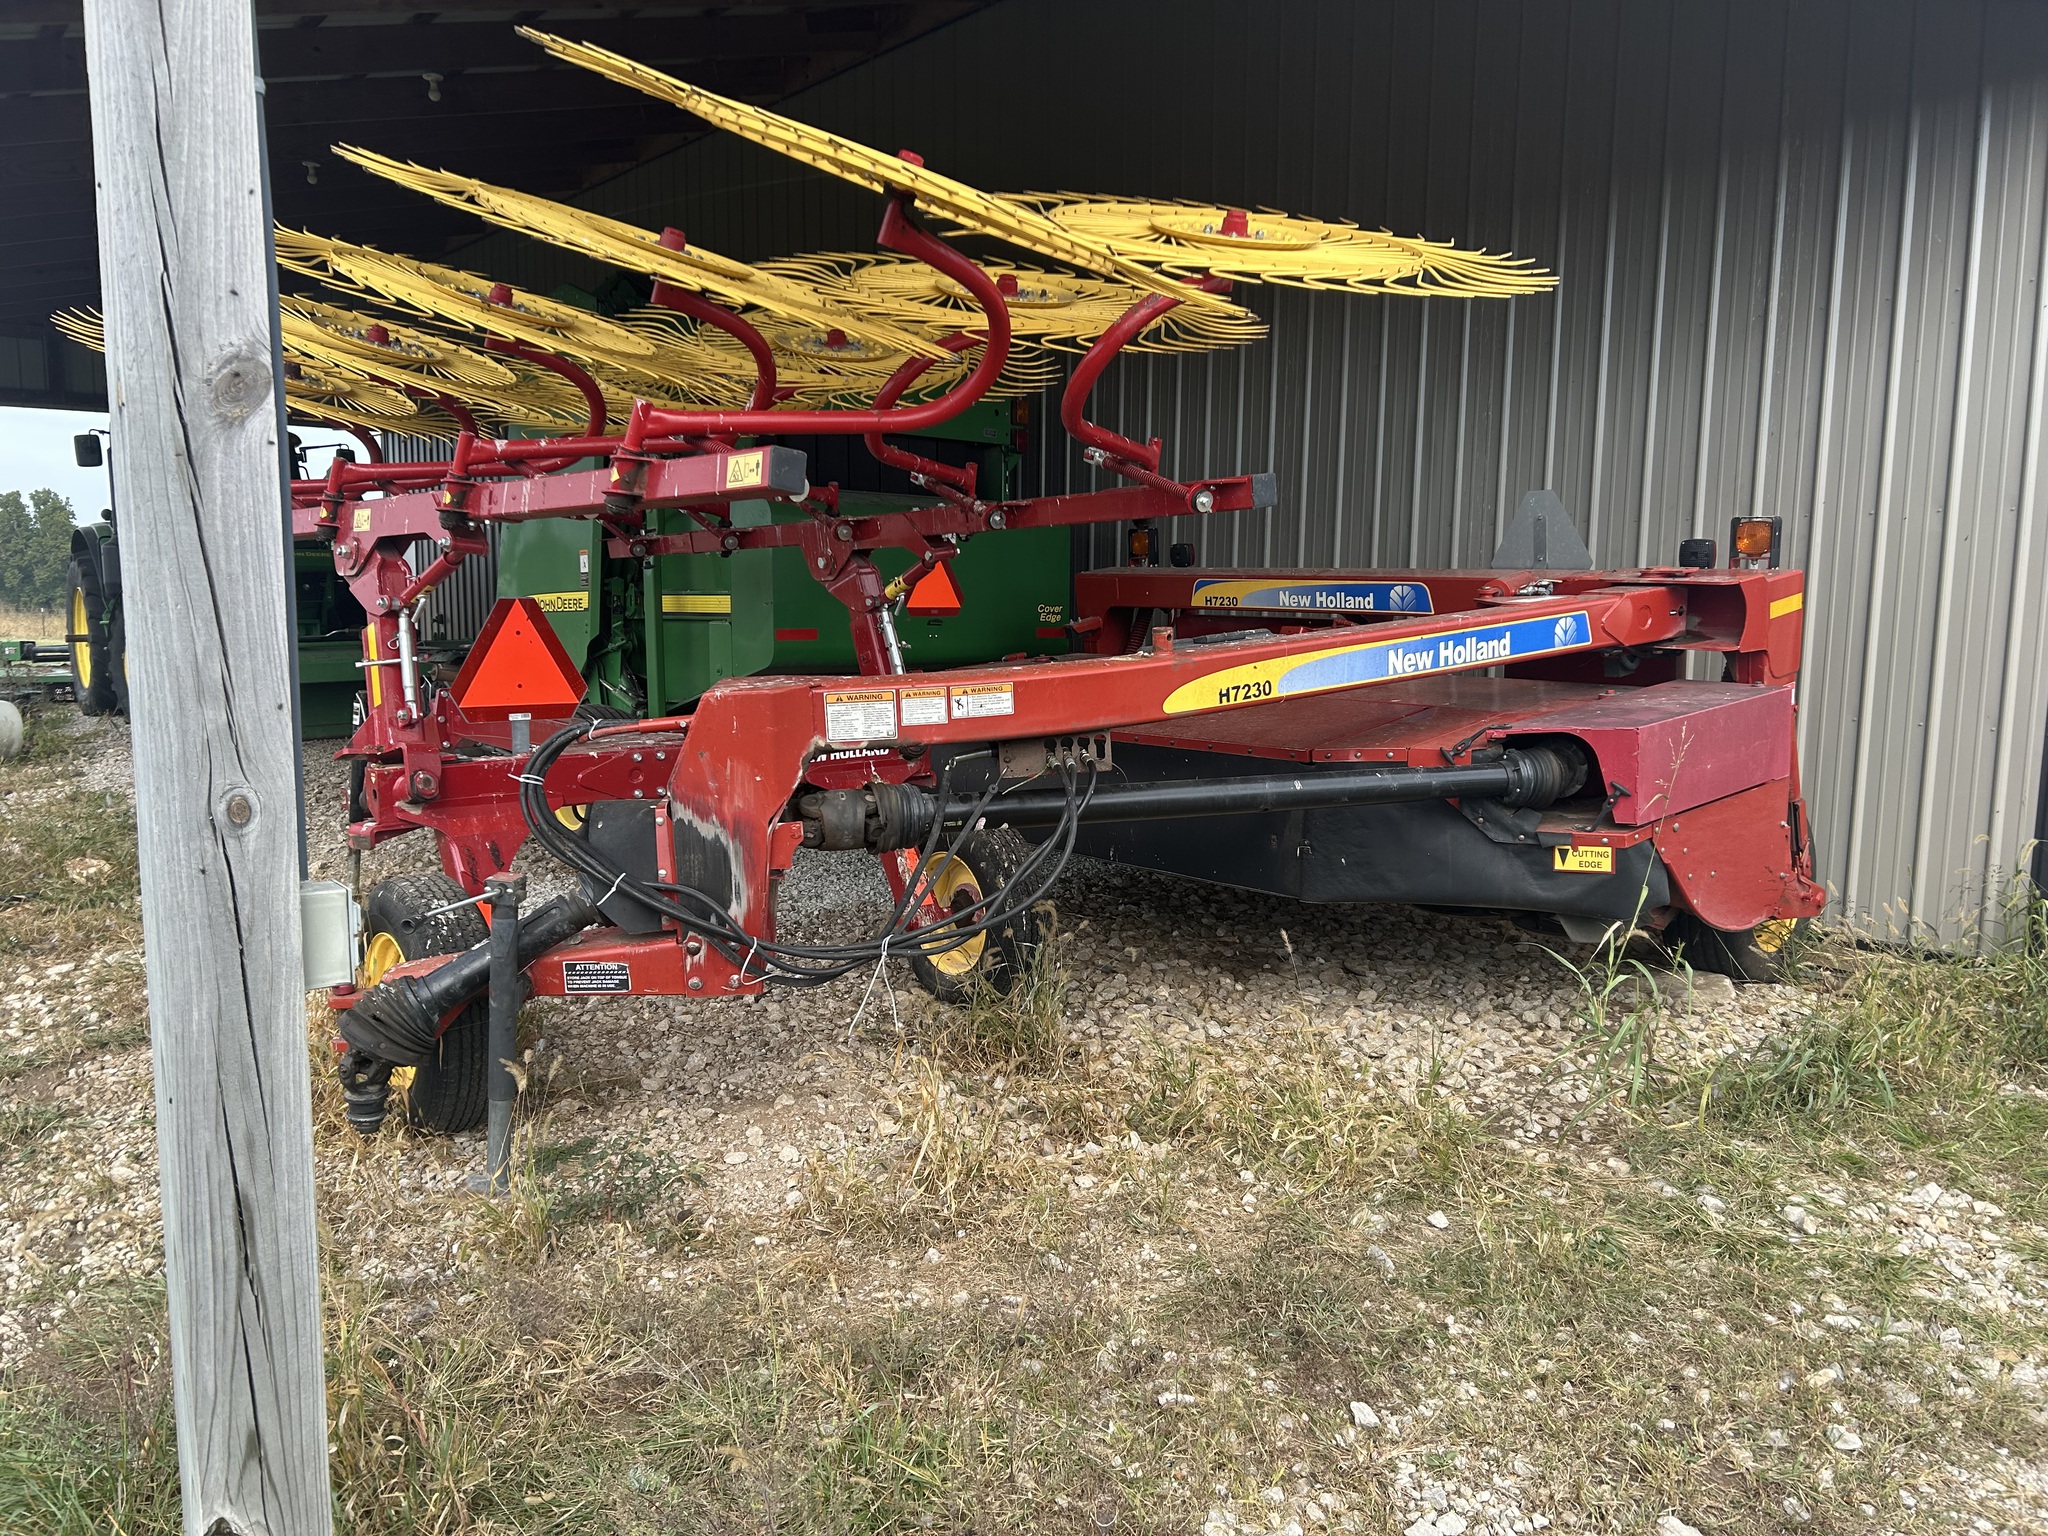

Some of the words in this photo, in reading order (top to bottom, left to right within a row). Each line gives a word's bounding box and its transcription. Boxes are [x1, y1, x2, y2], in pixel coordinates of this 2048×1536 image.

[537, 598, 556, 610] OHN
[557, 597, 583, 610] DEERE
[1204, 596, 1238, 607] H7230
[1278, 591, 1311, 607] New
[1315, 591, 1374, 609] Holland
[1037, 604, 1063, 613] Cover
[1040, 613, 1061, 623] Edge
[1387, 648, 1434, 675] New
[1439, 631, 1511, 667] Holland
[970, 685, 1004, 694] WARNING
[1218, 680, 1272, 704] H7230
[1572, 850, 1609, 858] CUTTING
